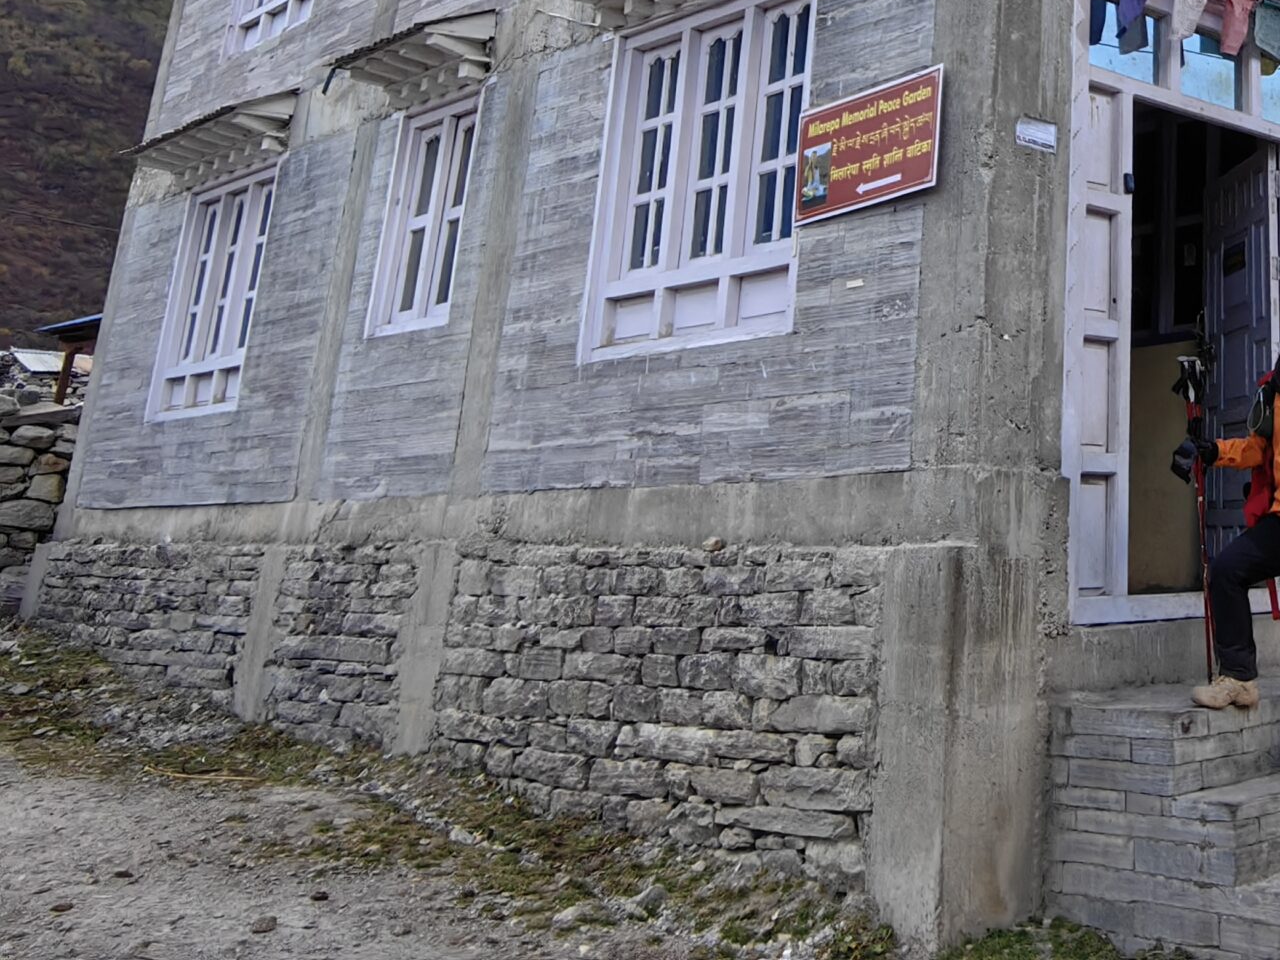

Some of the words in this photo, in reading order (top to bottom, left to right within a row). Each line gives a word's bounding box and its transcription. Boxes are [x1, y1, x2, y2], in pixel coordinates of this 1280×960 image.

[808, 117, 841, 138] Milarepa
[842, 102, 877, 127] Memorial
[878, 98, 901, 115] Peace
[902, 85, 932, 107] Garden
[862, 153, 881, 177] स्मृति
[906, 139, 933, 158] वाटिका
